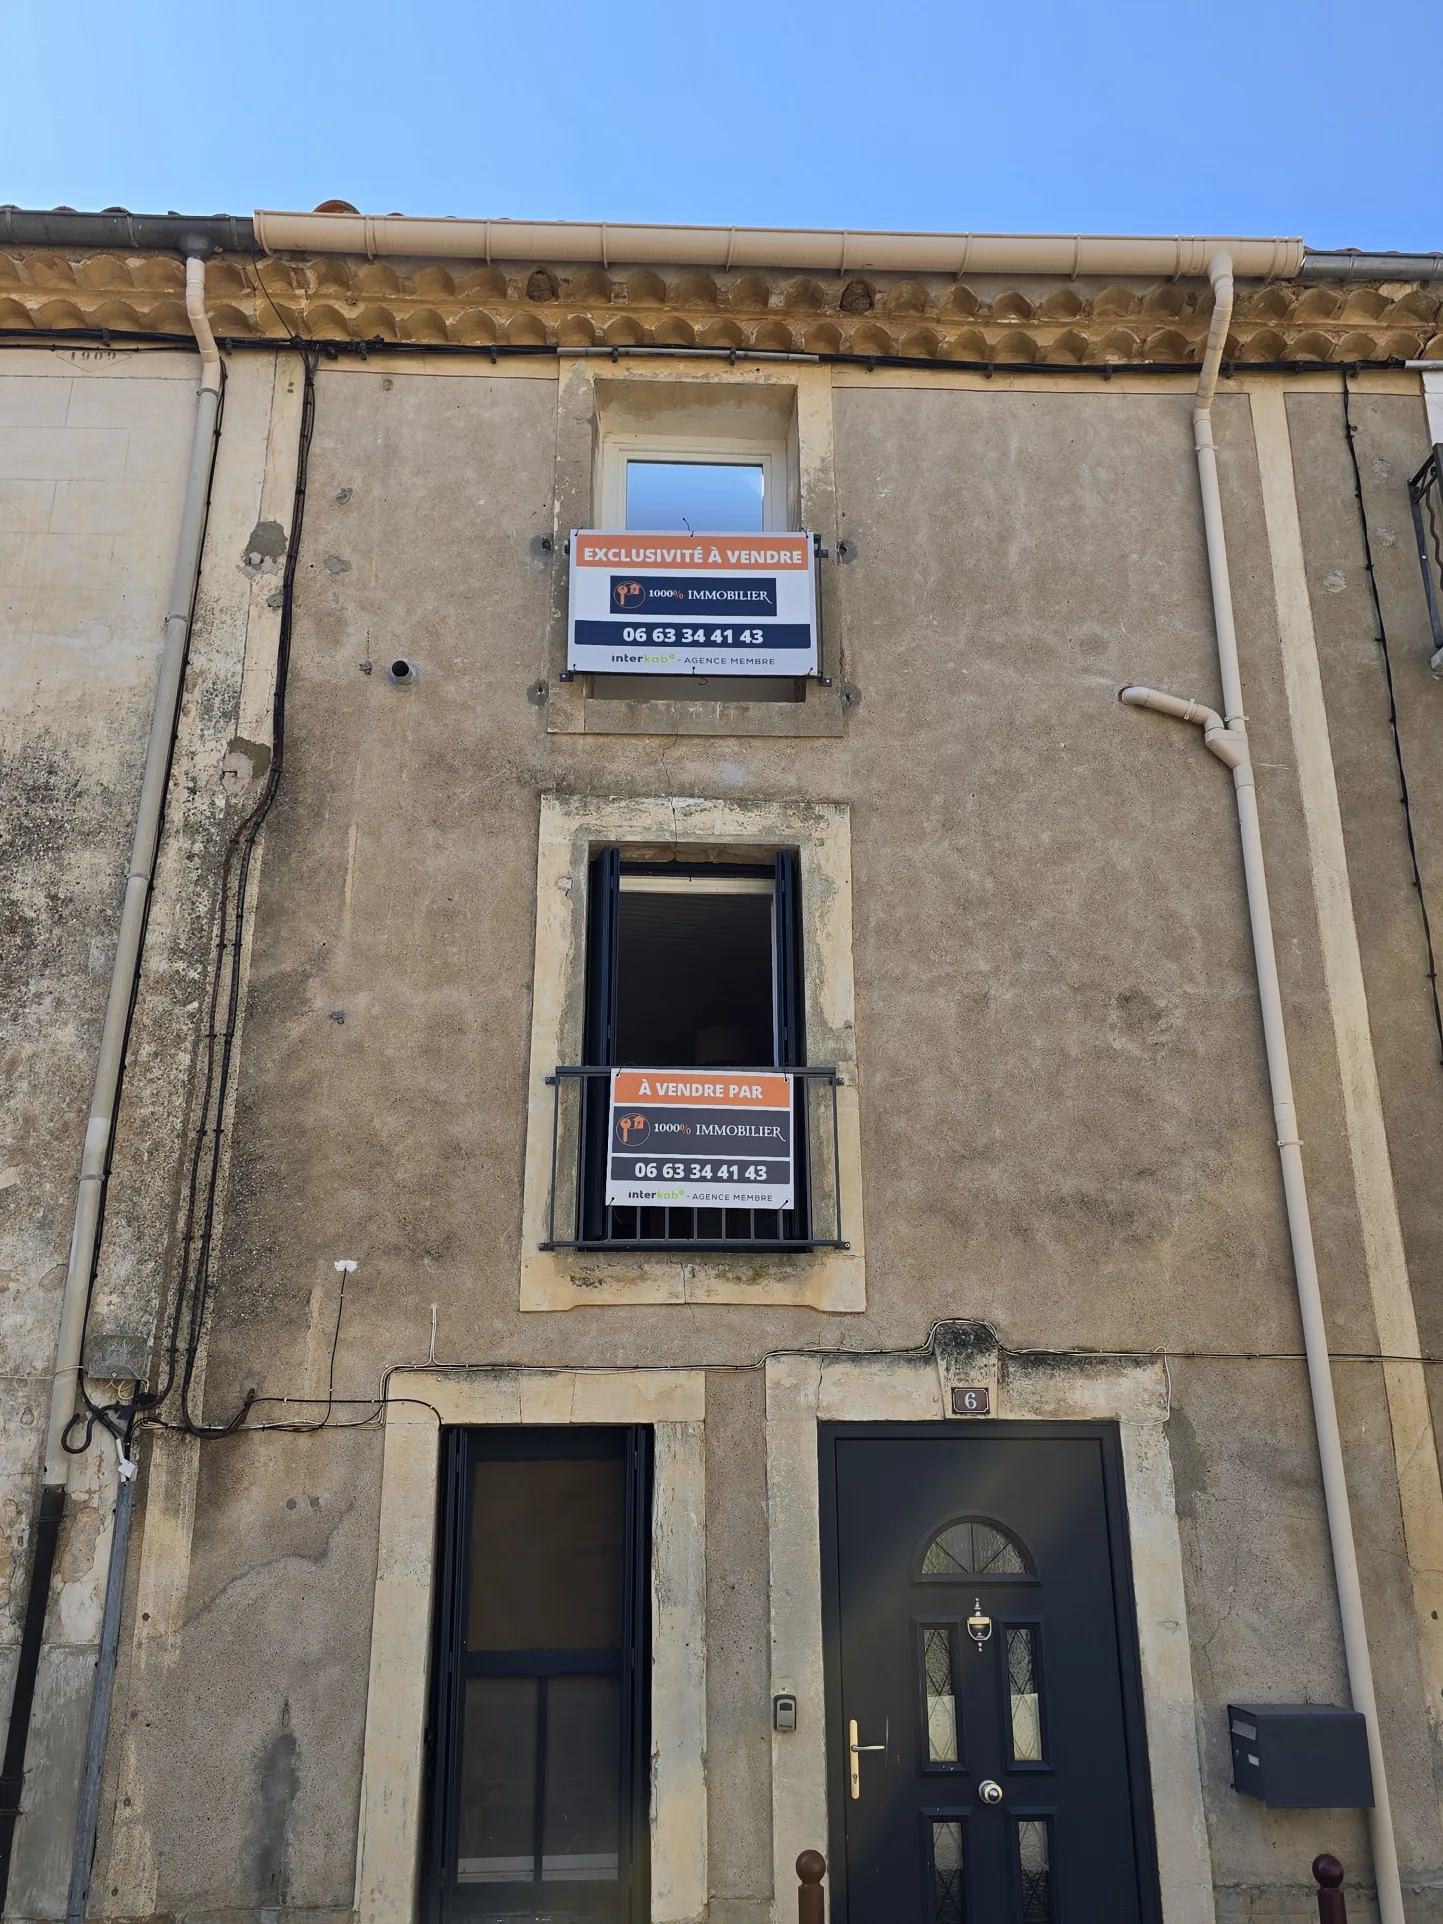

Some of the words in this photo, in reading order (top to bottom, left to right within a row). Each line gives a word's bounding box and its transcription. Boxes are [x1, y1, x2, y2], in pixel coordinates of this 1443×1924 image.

[584, 547, 703, 563] EXCLUSIVITÉ
[708, 547, 722, 564] À
[726, 550, 802, 564] VENDRE
[649, 590, 684, 600] 1000%
[688, 590, 772, 604] IMMOBILIER
[623, 628, 647, 642] 06
[652, 628, 676, 642] 63
[682, 628, 705, 643] 34
[710, 629, 733, 643] 41
[740, 629, 763, 644] 43
[684, 657, 728, 665] AGENCE
[730, 657, 775, 665] MEMBRE
[638, 1079, 651, 1095] À
[656, 1082, 724, 1098] VENDRE
[729, 1084, 763, 1099] PAR
[654, 1123, 691, 1135] 1000%
[696, 1124, 786, 1142] IMMOBILIER
[635, 1162, 657, 1178] 06
[662, 1163, 685, 1179] 63
[690, 1164, 713, 1180] 34
[717, 1165, 739, 1180] 41
[744, 1166, 767, 1181] 43
[692, 1193, 730, 1201] AGENCE
[733, 1194, 773, 1202] MEMBRE
[965, 1392, 977, 1409] 6
